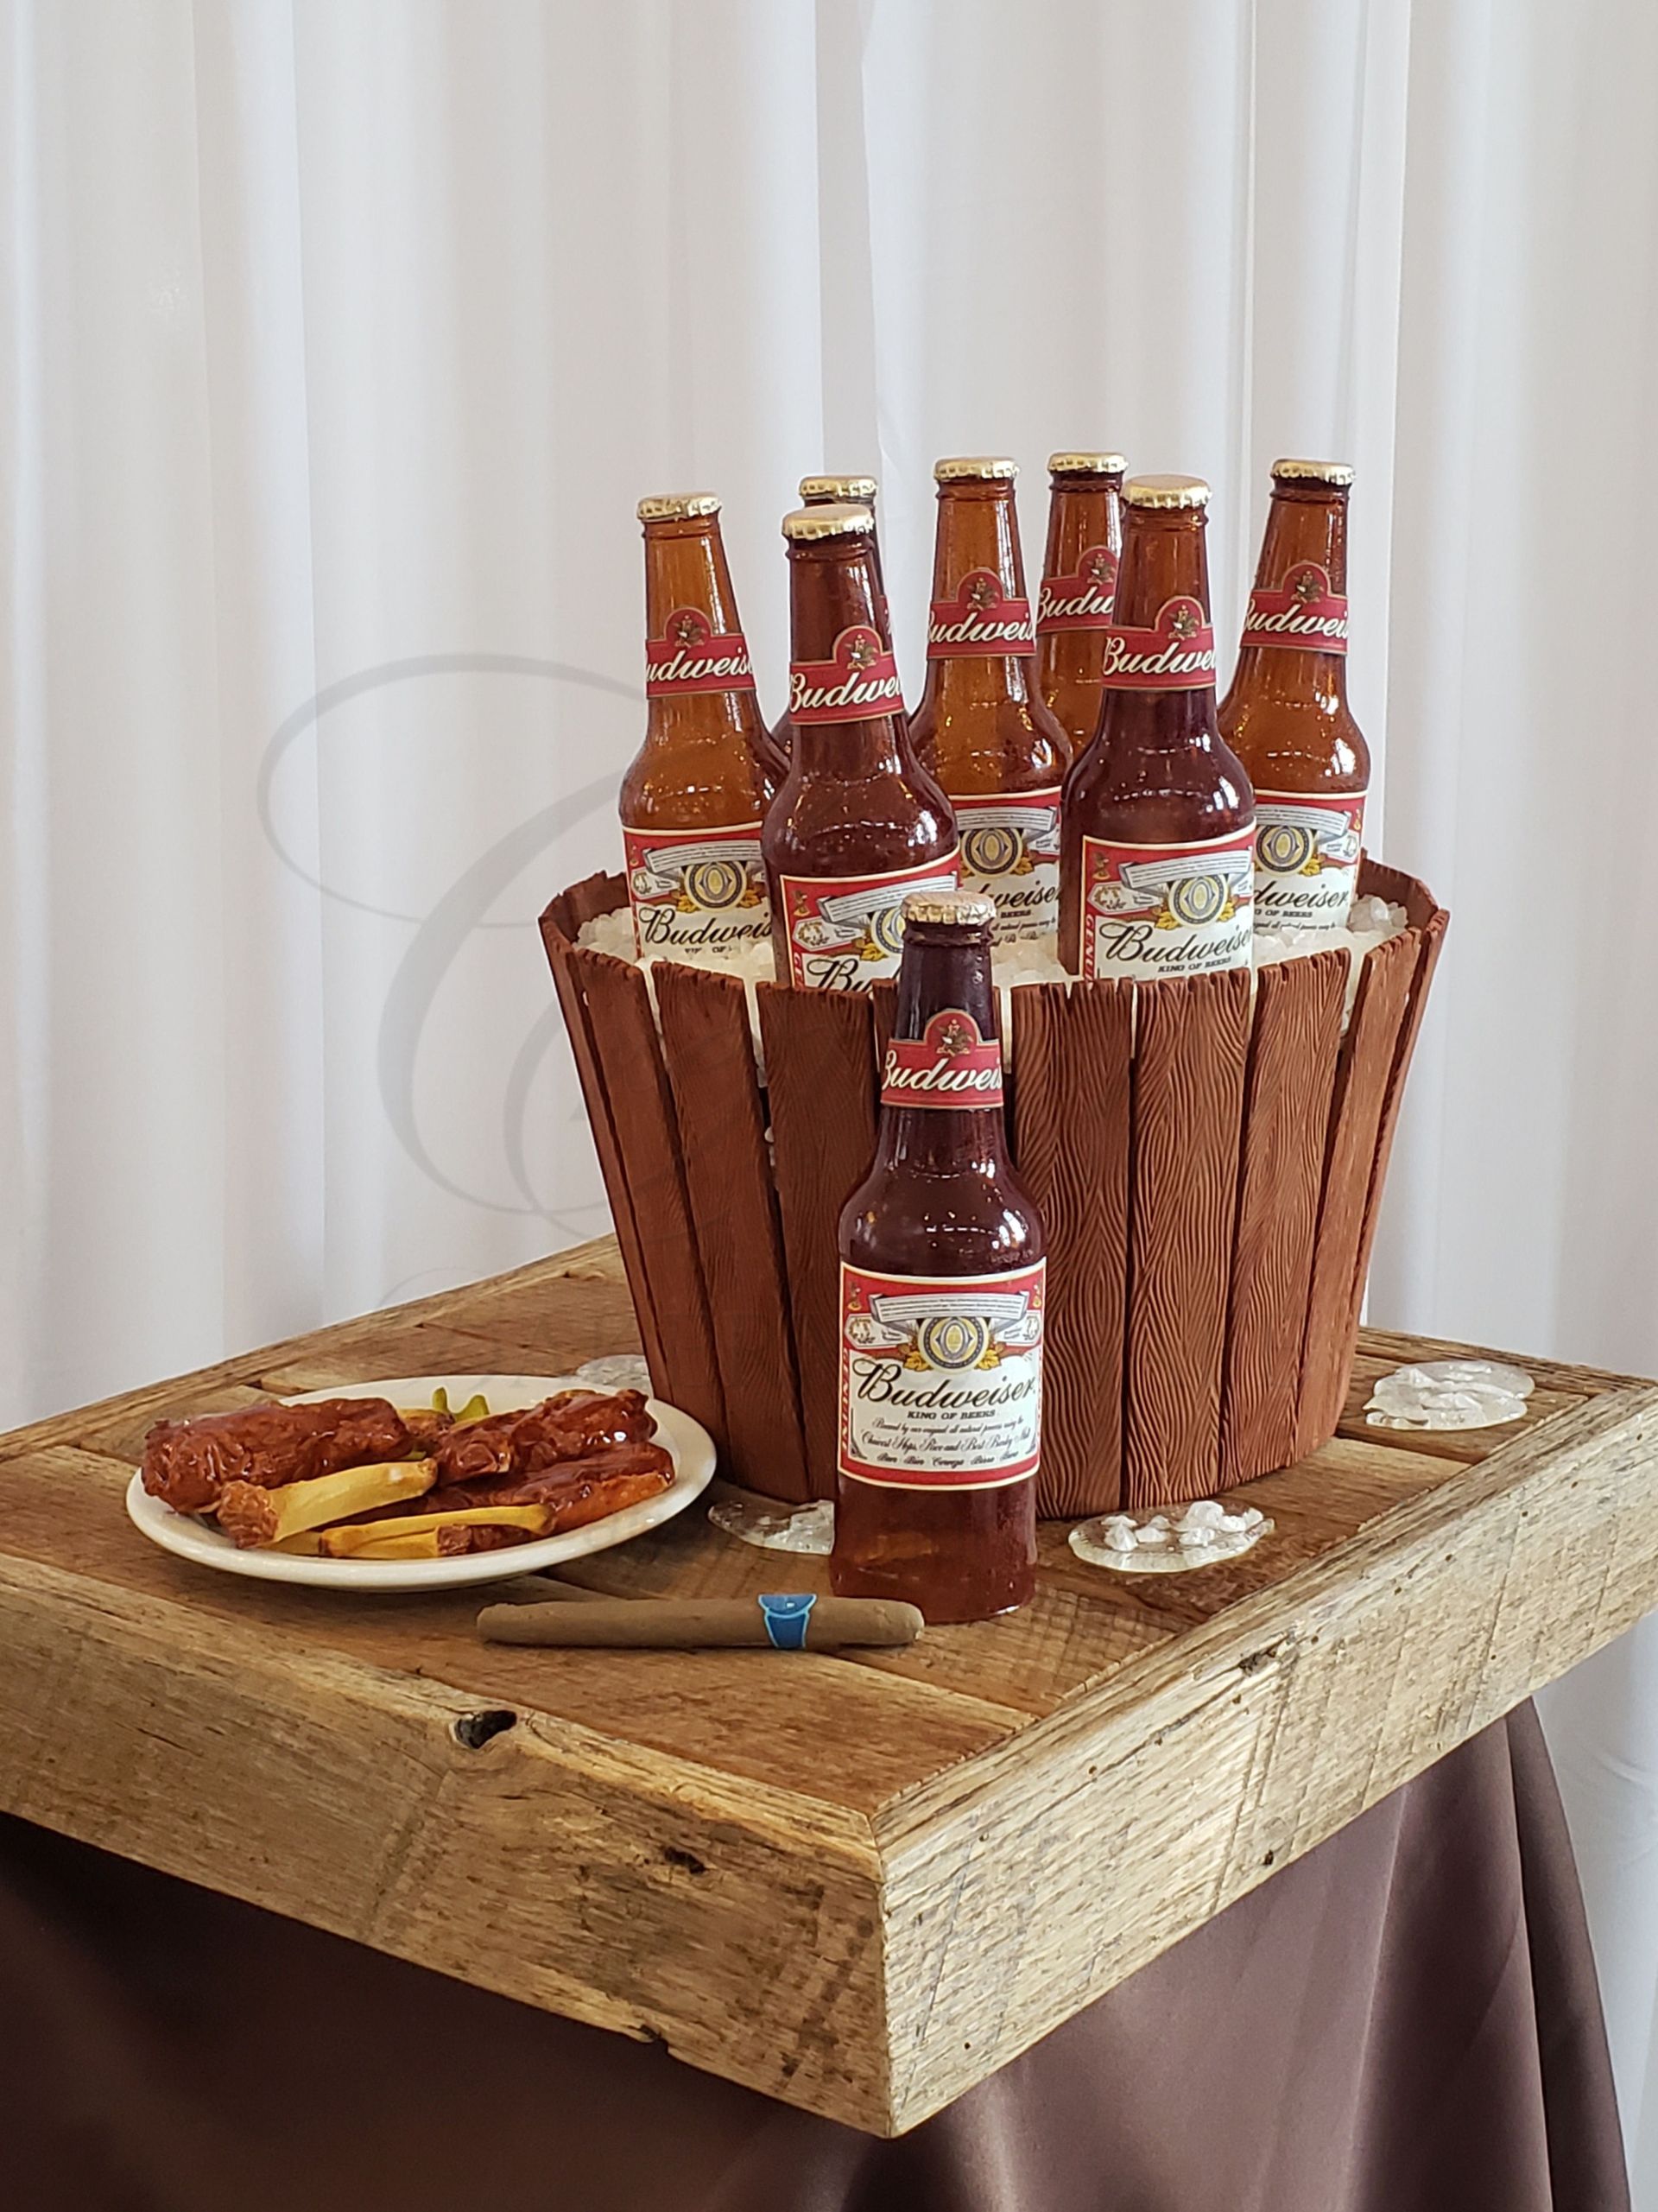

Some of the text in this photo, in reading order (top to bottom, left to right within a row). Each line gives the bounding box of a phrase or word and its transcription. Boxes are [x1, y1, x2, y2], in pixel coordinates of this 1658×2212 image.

[1188, 961, 1203, 971] OF
[851, 1358, 1036, 1409] Budweiser
[907, 1409, 996, 1421] KING OF BEERS
